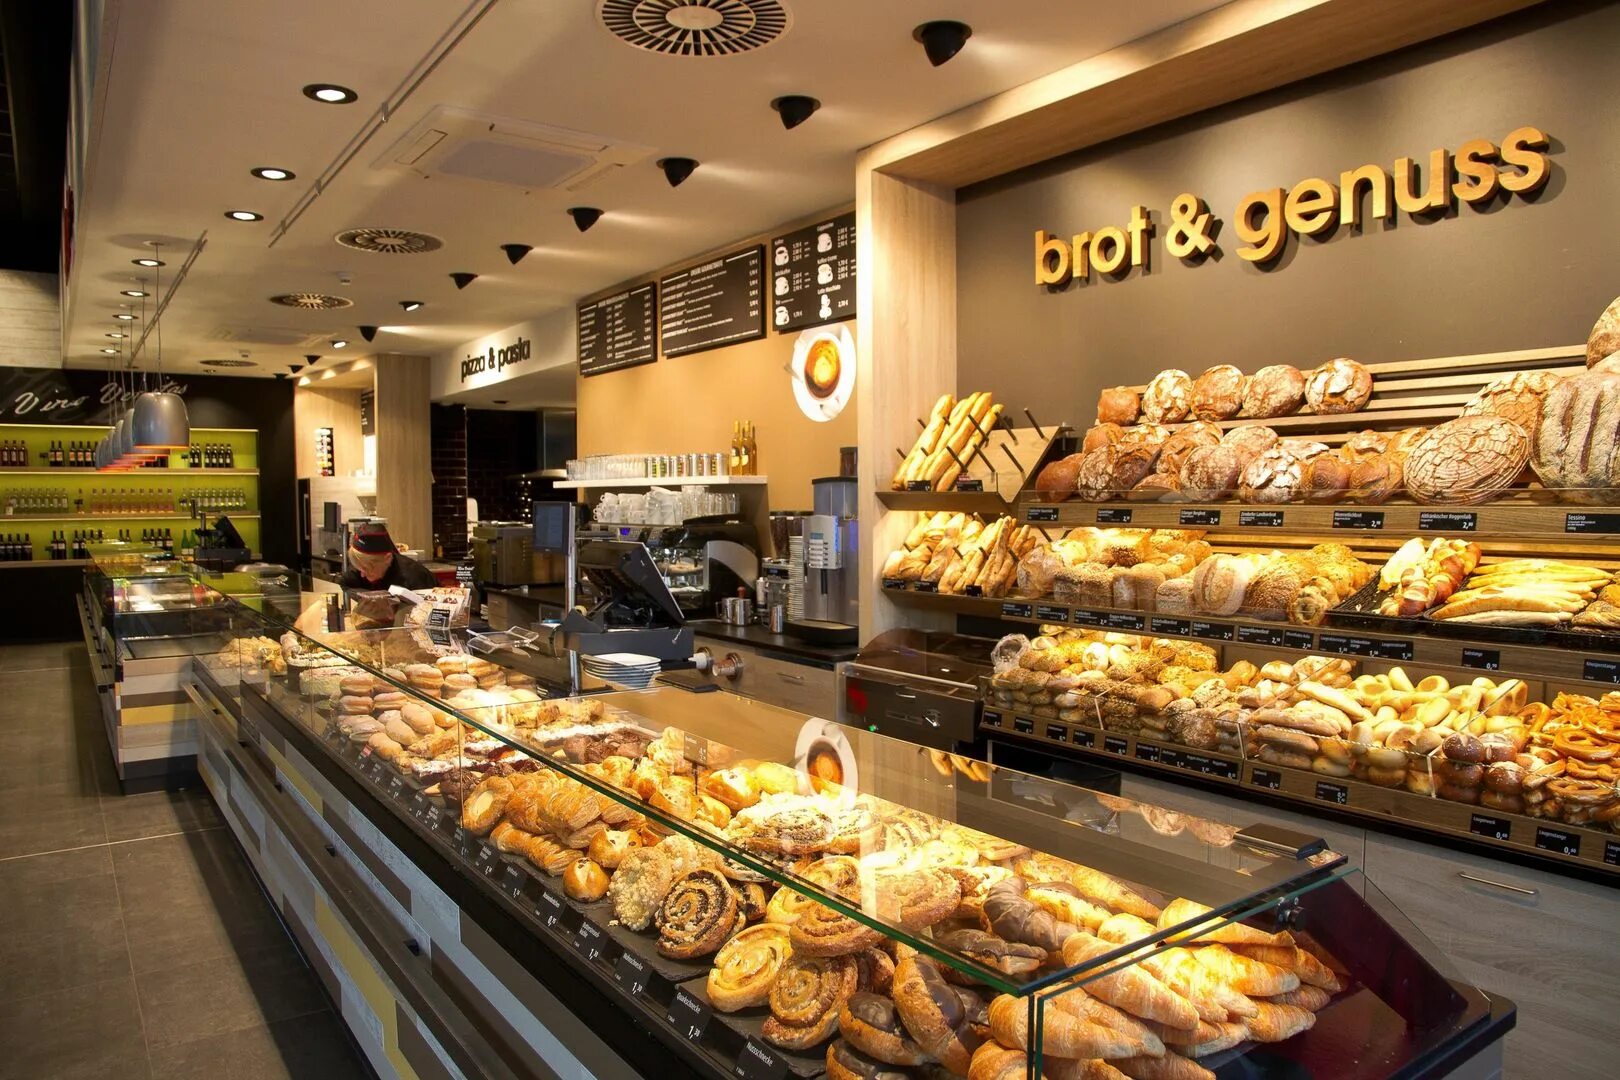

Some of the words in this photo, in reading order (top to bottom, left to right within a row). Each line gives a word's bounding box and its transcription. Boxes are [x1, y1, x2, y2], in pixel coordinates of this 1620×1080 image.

[1035, 205, 1153, 286] brot
[1166, 192, 1217, 259] &
[1233, 126, 1551, 264] genuss
[461, 354, 486, 383] pizza
[488, 346, 496, 370] &
[497, 336, 531, 373] pasta
